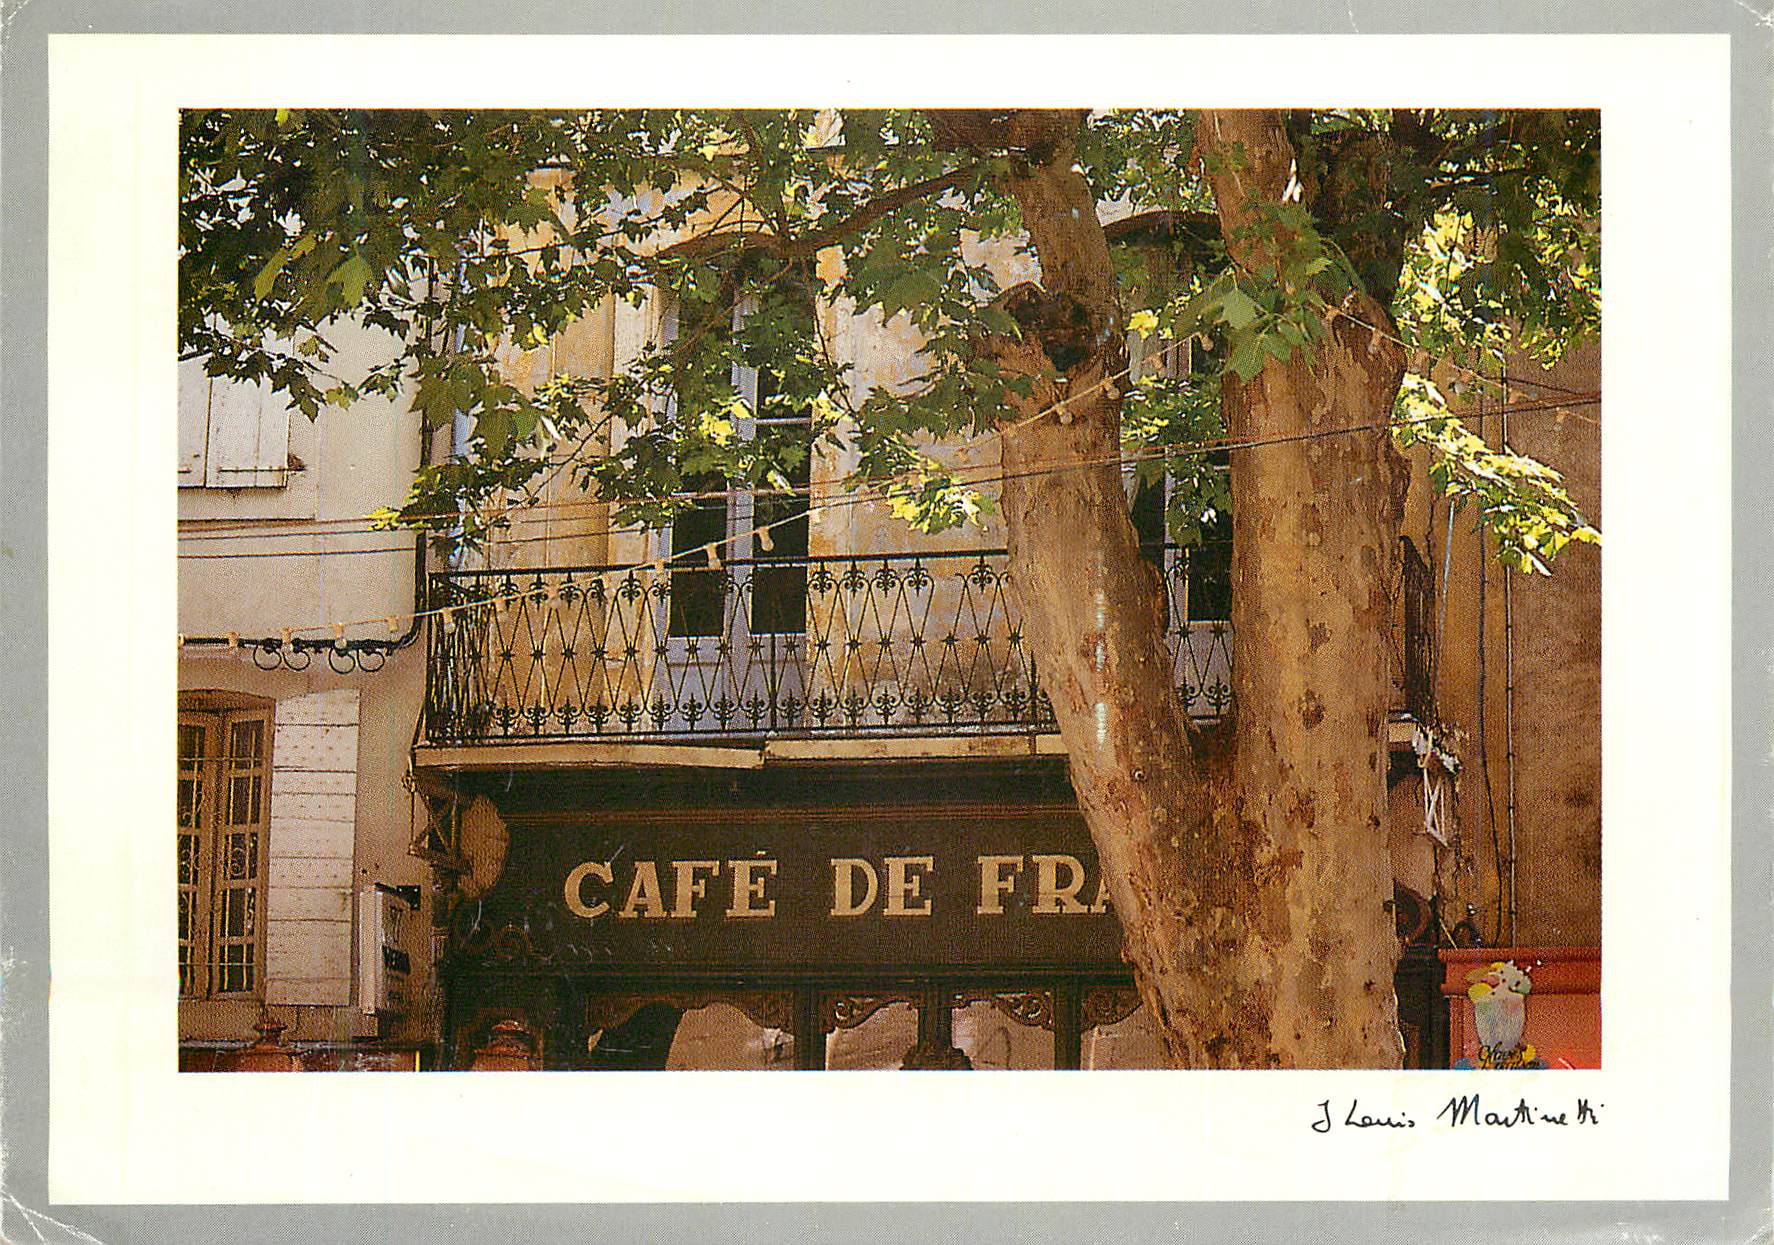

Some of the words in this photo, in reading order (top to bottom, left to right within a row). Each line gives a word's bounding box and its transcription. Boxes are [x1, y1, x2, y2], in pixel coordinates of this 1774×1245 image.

[563, 851, 779, 918] CAFÉ
[831, 856, 935, 916] DE
[1437, 1093, 1605, 1128] Martinetti
